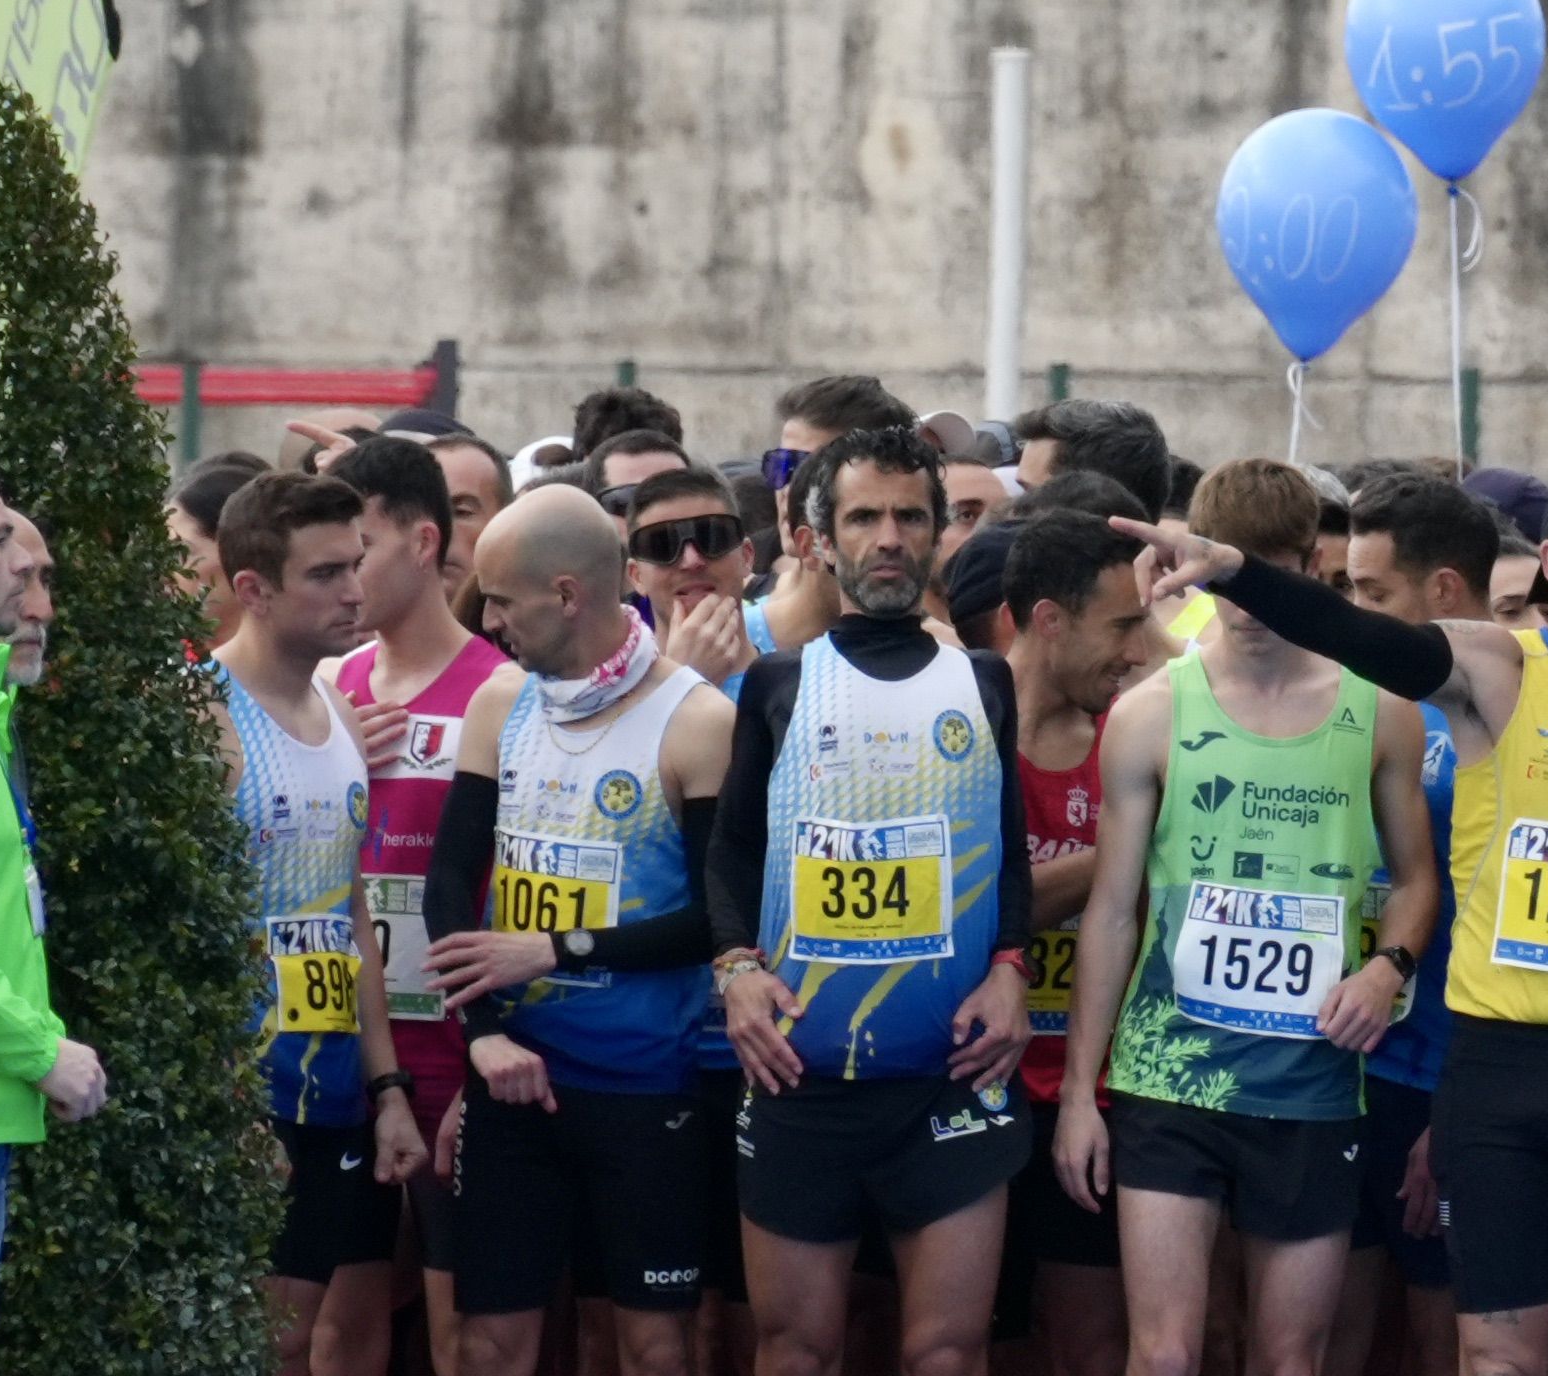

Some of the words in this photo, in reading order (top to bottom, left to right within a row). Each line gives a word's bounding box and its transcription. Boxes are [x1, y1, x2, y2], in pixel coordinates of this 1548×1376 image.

[1242, 800, 1320, 828] Unicaja
[1243, 780, 1351, 808] Fundación
[812, 824, 857, 861] 21K
[500, 874, 586, 932] 1061
[821, 865, 910, 920] 334
[1203, 886, 1256, 926] 21K
[1200, 934, 1314, 998] 1529
